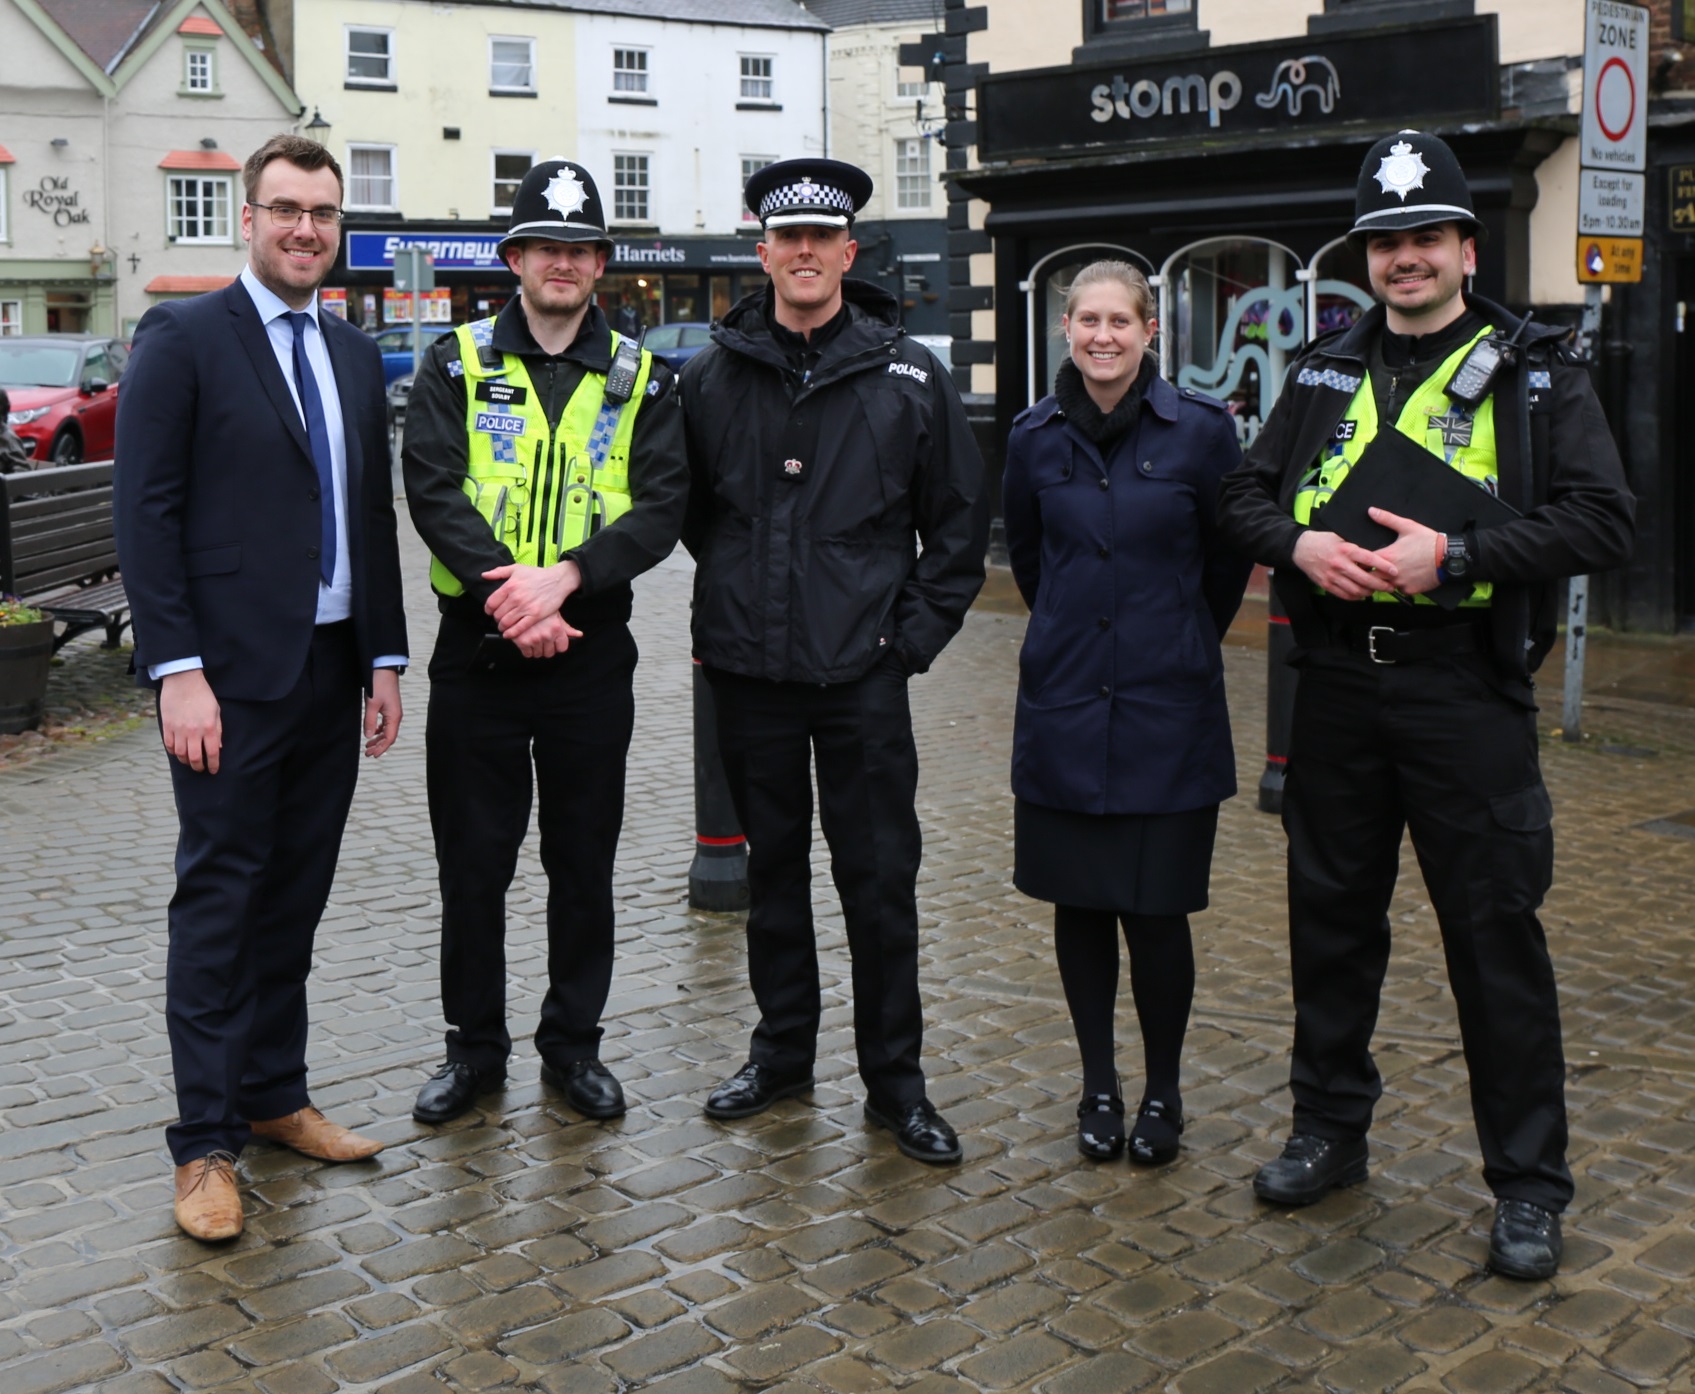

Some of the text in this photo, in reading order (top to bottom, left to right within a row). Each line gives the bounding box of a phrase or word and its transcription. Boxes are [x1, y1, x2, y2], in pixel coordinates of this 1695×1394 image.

[1592, 0, 1645, 22] PEDESTRIAN
[1599, 23, 1636, 49] ZONE
[1090, 70, 1242, 127] stomp
[1591, 146, 1636, 164] No vehicles
[40, 175, 69, 192] Old
[1593, 175, 1633, 192] Except for
[22, 190, 79, 215] Royal
[1598, 193, 1628, 210] loading
[54, 208, 91, 228] Oak
[383, 236, 500, 260] Sernew
[615, 244, 686, 263] Harriets
[887, 362, 929, 384] POLICE
[489, 385, 515, 395] SERGEANT
[478, 415, 522, 432] POLICE
